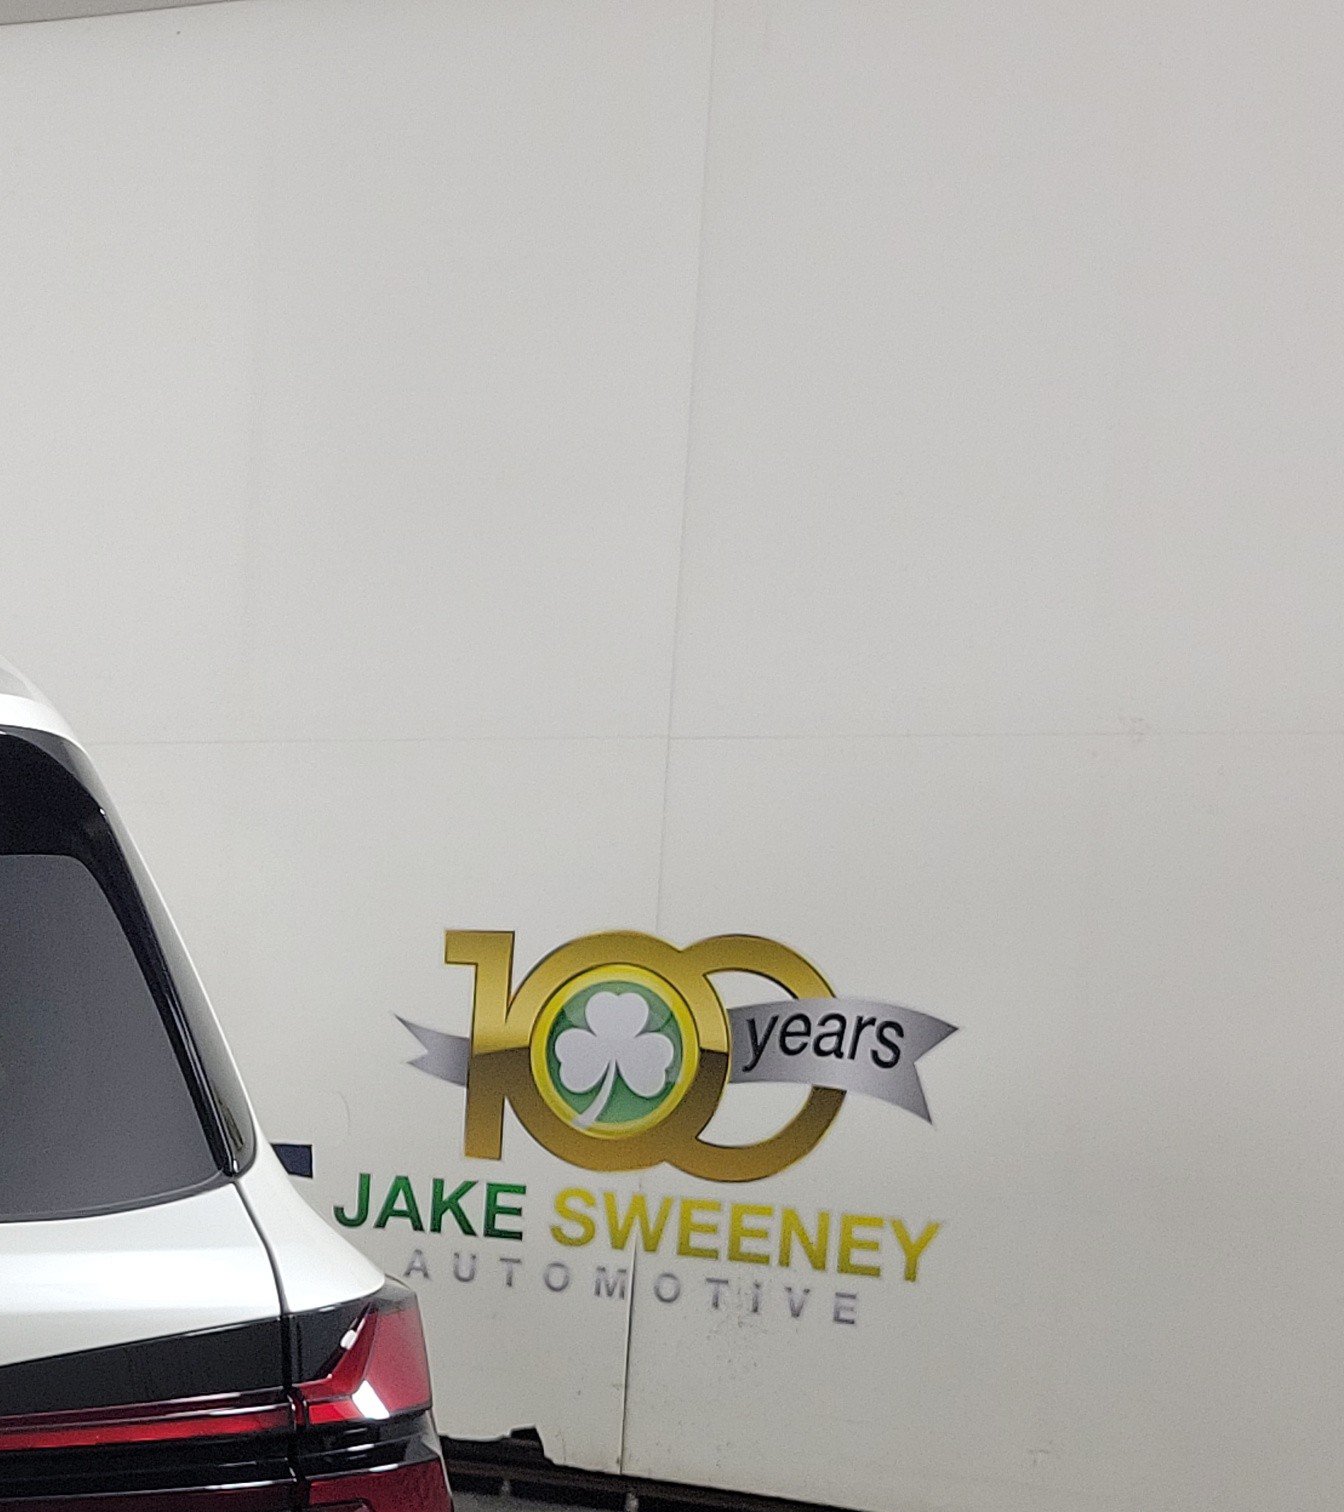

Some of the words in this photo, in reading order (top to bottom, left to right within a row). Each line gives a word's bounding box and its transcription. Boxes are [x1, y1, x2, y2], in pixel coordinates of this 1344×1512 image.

[444, 929, 846, 1183] 100
[742, 1011, 905, 1073] years
[332, 1171, 528, 1241] JAKE
[549, 1187, 941, 1283] SWEENEY
[404, 1248, 859, 1326] AUTOMOTIVE
